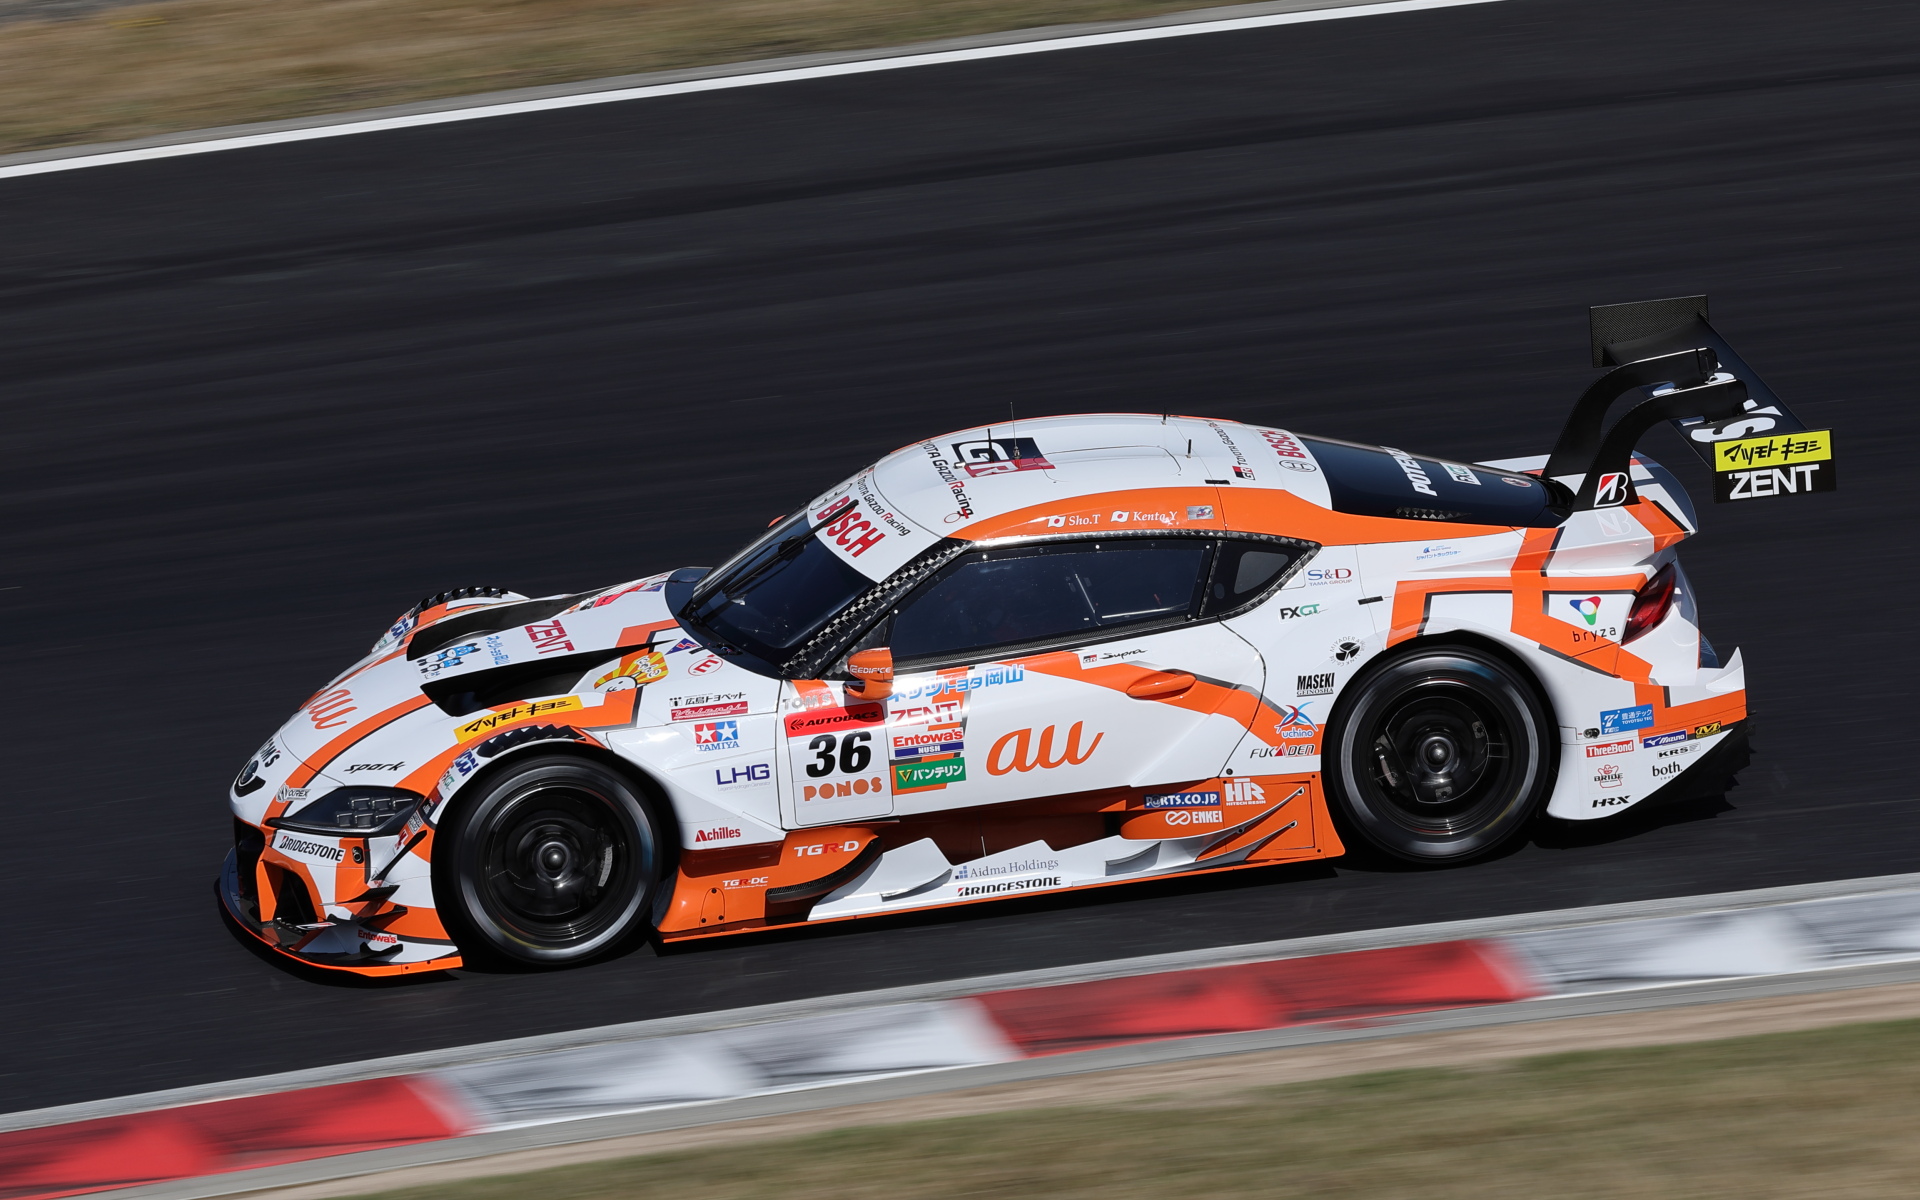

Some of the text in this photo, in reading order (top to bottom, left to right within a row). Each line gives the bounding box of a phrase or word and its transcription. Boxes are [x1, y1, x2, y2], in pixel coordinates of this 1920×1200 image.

[932, 460, 957, 484] GAZOO
[948, 480, 974, 517] Racing
[1729, 464, 1820, 500] ZENT
[863, 493, 885, 515] GAZOO
[881, 512, 911, 537] Racing
[1068, 514, 1101, 527] Sho.T
[1307, 568, 1352, 580] S&D
[1328, 578, 1353, 586] GROUP
[524, 619, 575, 655] ZENT
[1572, 626, 1617, 642] bryza
[1099, 648, 1148, 660] Supra
[857, 665, 892, 674] EDIFICE
[1296, 672, 1335, 690] MASEKI
[805, 711, 878, 727] AUTOBACS
[890, 702, 960, 728] ZENT
[1622, 716, 1644, 725] TOYOTSU
[893, 728, 963, 748] Entowa's
[1282, 728, 1314, 738] uchino
[697, 741, 740, 752] TAMIYA
[806, 731, 872, 778] 36
[986, 720, 1104, 776] au
[1587, 741, 1634, 758] ThreeBond
[1658, 746, 1689, 758] KRS
[343, 762, 405, 774] spark
[716, 763, 770, 785] LHG
[912, 764, 963, 781] バンテリン
[1594, 772, 1624, 782] BRIDE
[803, 777, 883, 802] PONOS
[1592, 795, 1631, 808] HRX
[1192, 810, 1223, 823] ENKEI
[695, 826, 741, 843] Achilles
[279, 835, 345, 862] BRIDGESTONE
[794, 840, 860, 857] TGR-D
[970, 859, 1059, 878] Aidma Holdings
[722, 876, 769, 887] TGR-DC
[957, 876, 1062, 897] BRIDGESTONE
[357, 929, 398, 944] Entowa's
